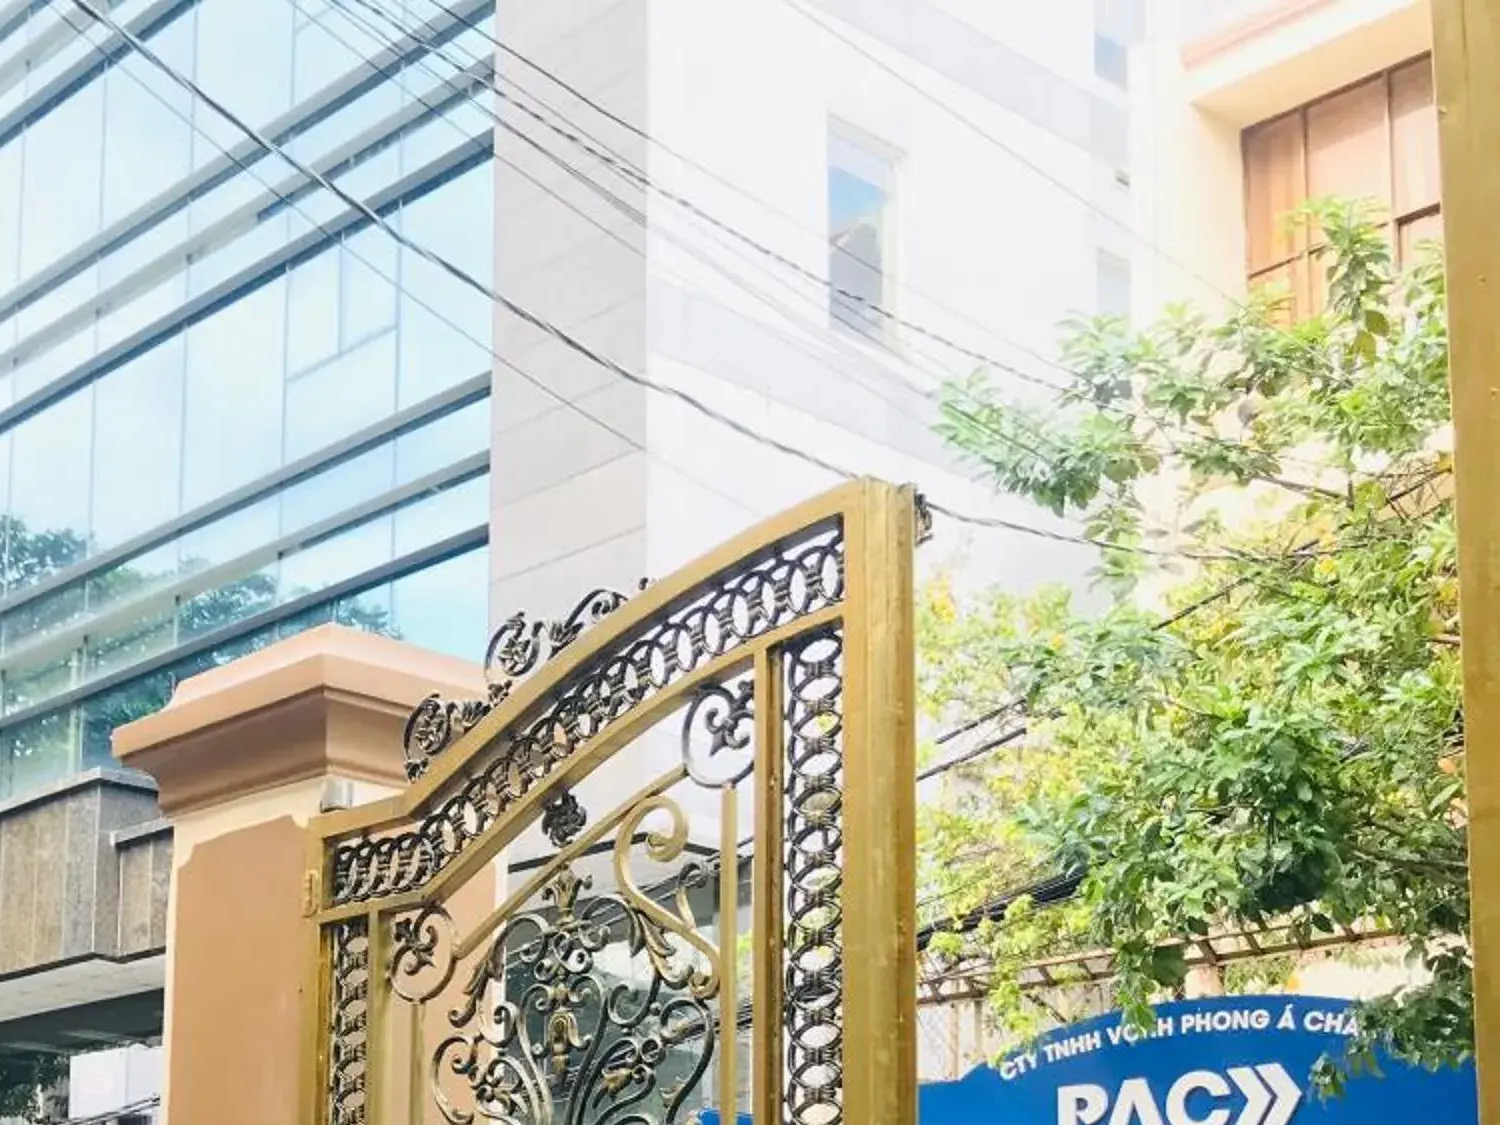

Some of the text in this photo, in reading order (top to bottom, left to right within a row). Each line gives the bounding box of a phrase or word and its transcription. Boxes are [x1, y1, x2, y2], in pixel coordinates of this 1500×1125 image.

[1044, 1030, 1101, 1063] TNHH
[1181, 1009, 1270, 1034] PHONG
[1276, 1003, 1295, 1030] Á
